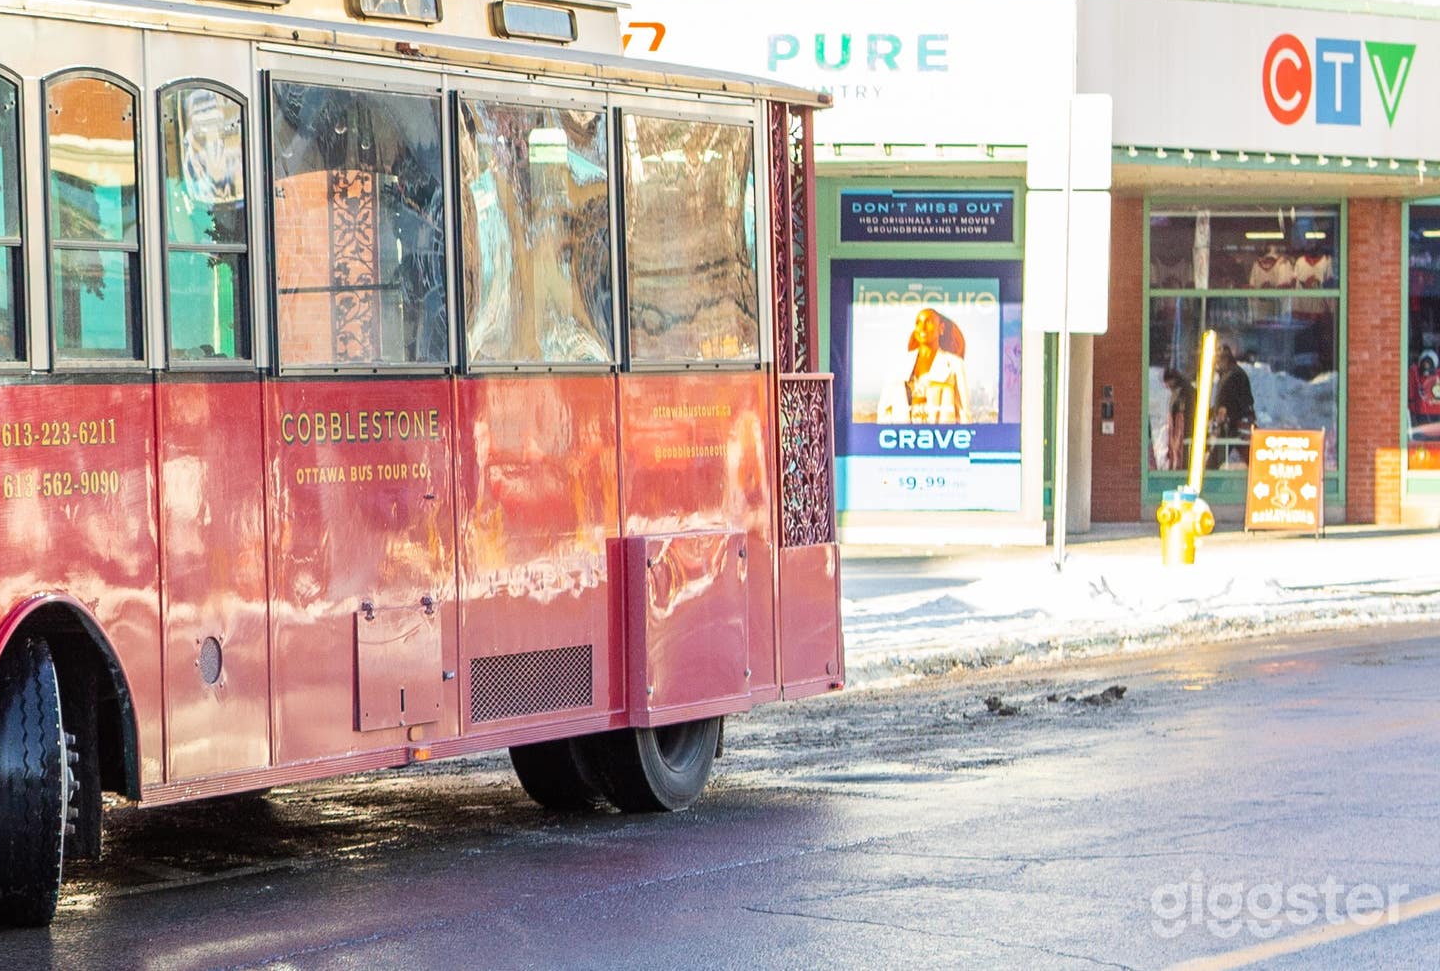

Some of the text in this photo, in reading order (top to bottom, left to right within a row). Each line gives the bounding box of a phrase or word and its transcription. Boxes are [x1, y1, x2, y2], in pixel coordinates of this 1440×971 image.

[767, 33, 949, 73] PURE
[1266, 41, 1412, 121] CTV
[852, 202, 1004, 214] DON'T MISS OUT
[881, 216, 931, 226] ORIGINALS
[942, 217, 957, 226] HIT
[960, 217, 996, 226] MOVIES
[867, 225, 988, 235] GROUNDBREAKING SHOWS
[1, 418, 117, 447] 613-223-6211
[281, 409, 440, 446] COBBLESTONE
[3, 470, 120, 499] 613-562-9090
[296, 466, 346, 484] OTTAWA
[350, 465, 373, 482] BUS
[377, 464, 408, 481] TOUR
